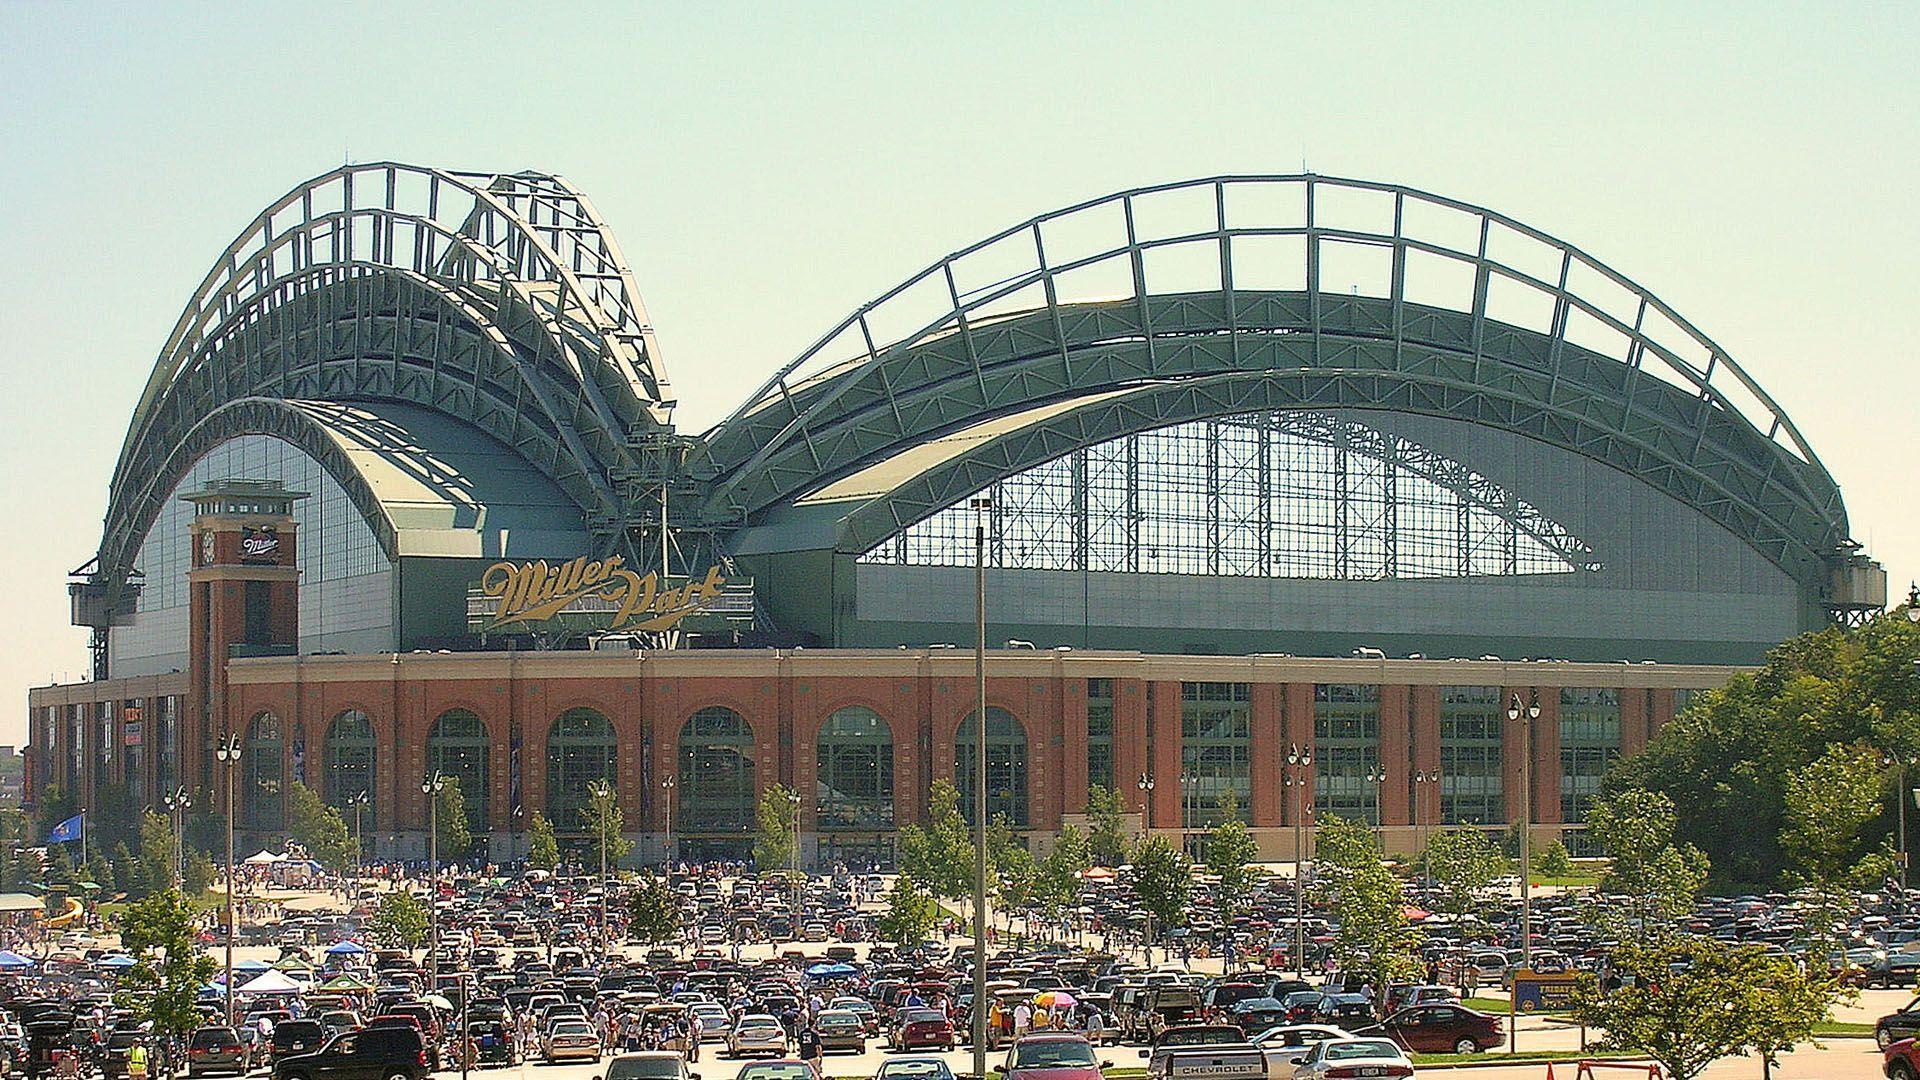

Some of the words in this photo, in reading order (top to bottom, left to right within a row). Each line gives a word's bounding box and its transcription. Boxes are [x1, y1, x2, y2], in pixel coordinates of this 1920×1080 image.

[243, 538, 279, 555] Miller
[482, 555, 626, 626] Miller
[598, 565, 726, 629] Park
[1183, 1065, 1254, 1075] CHEVROLET
